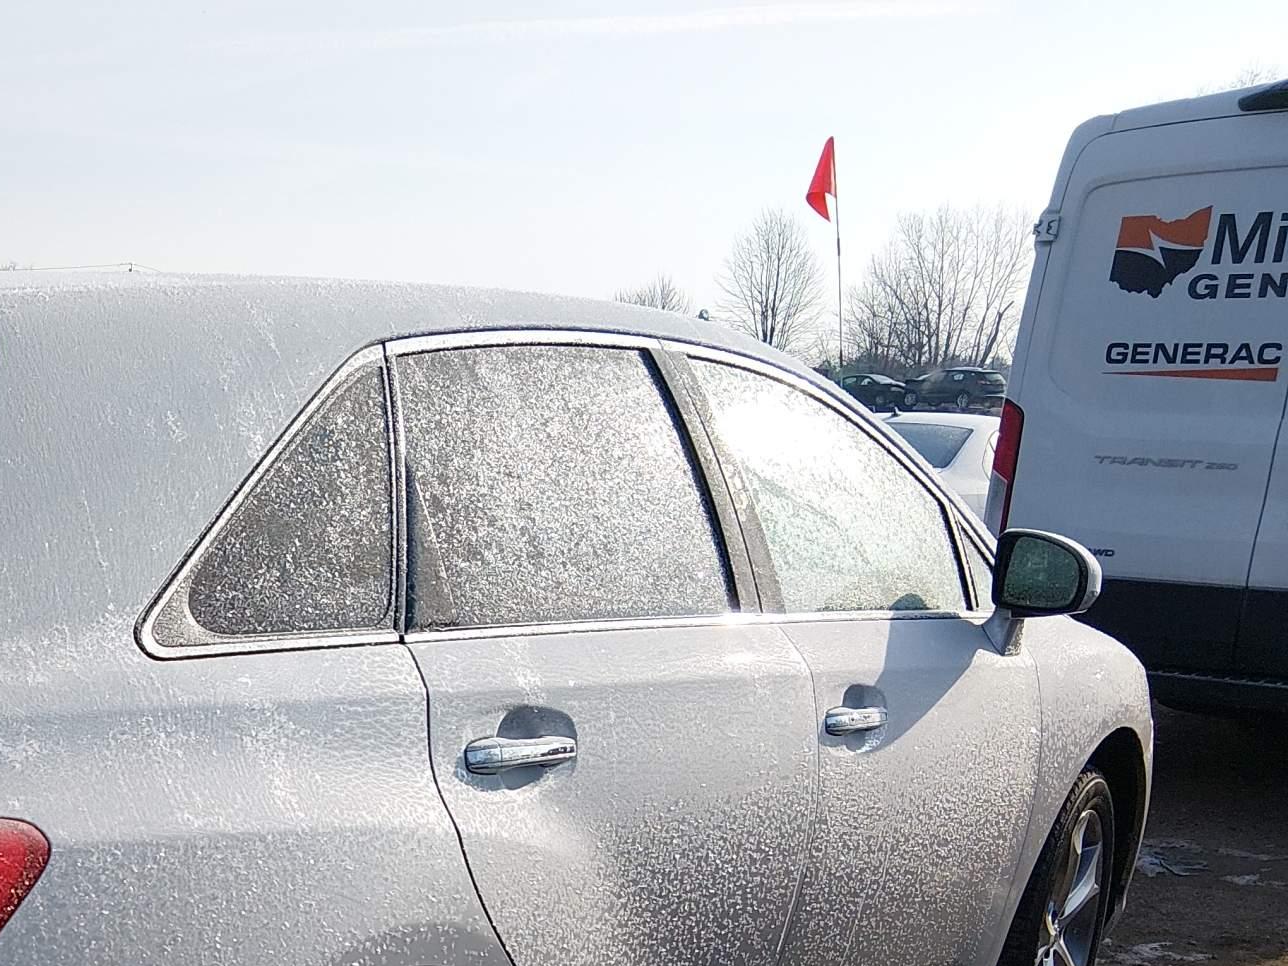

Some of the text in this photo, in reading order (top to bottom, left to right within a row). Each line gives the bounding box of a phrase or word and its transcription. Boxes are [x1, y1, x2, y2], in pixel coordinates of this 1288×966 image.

[1211, 211, 1288, 265] Mi
[1187, 272, 1288, 300] GEN
[1105, 342, 1283, 365] GENERAC
[1094, 455, 1204, 469] TRANSIT
